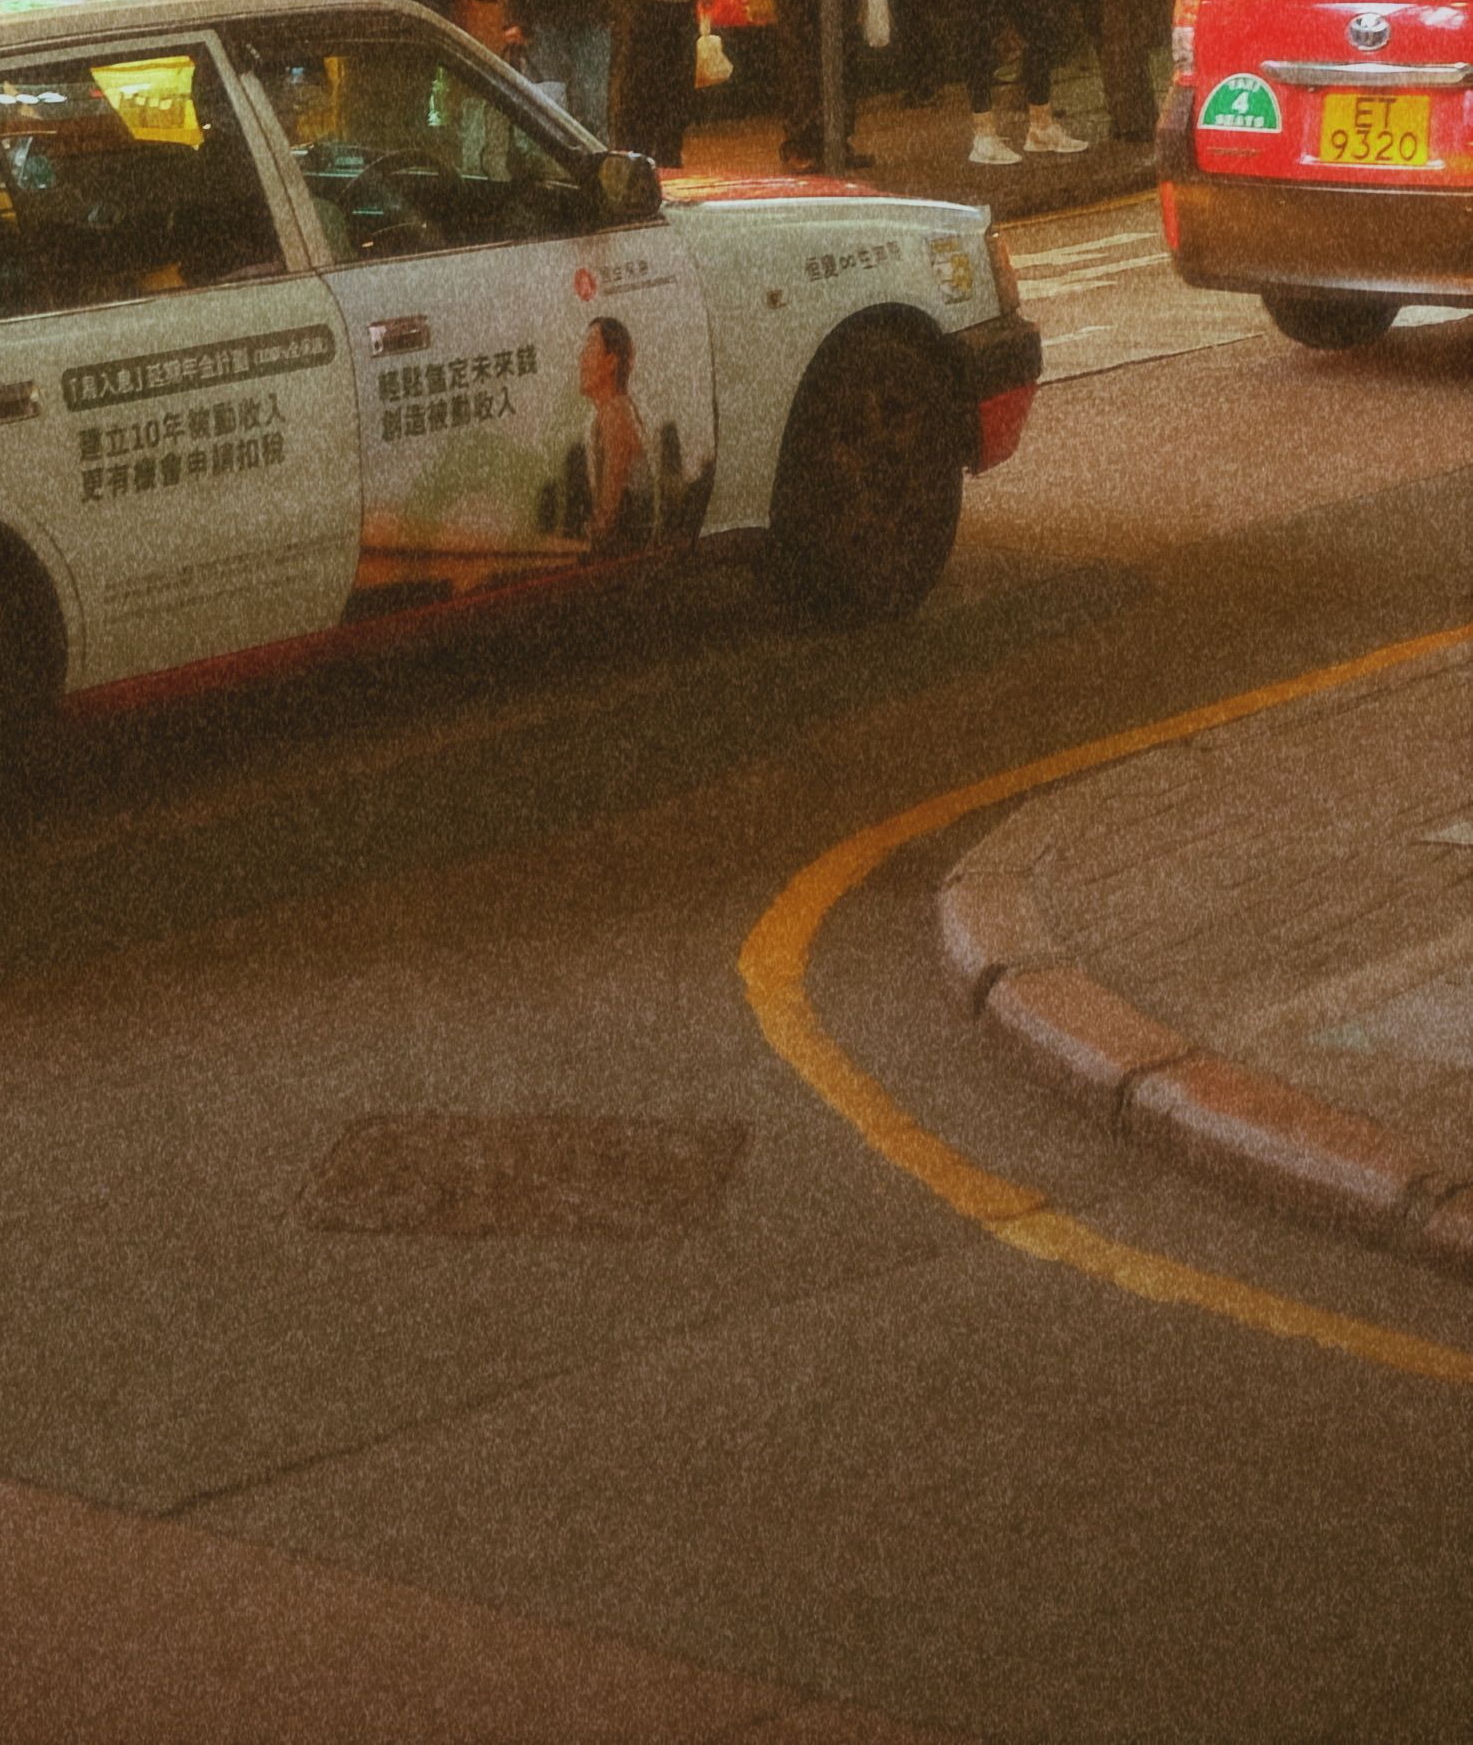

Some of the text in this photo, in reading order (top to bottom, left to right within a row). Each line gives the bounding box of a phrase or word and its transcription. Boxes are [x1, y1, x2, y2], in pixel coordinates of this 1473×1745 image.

[1231, 91, 1250, 114] 4
[1353, 97, 1397, 129] ET
[1331, 128, 1419, 162] 9320
